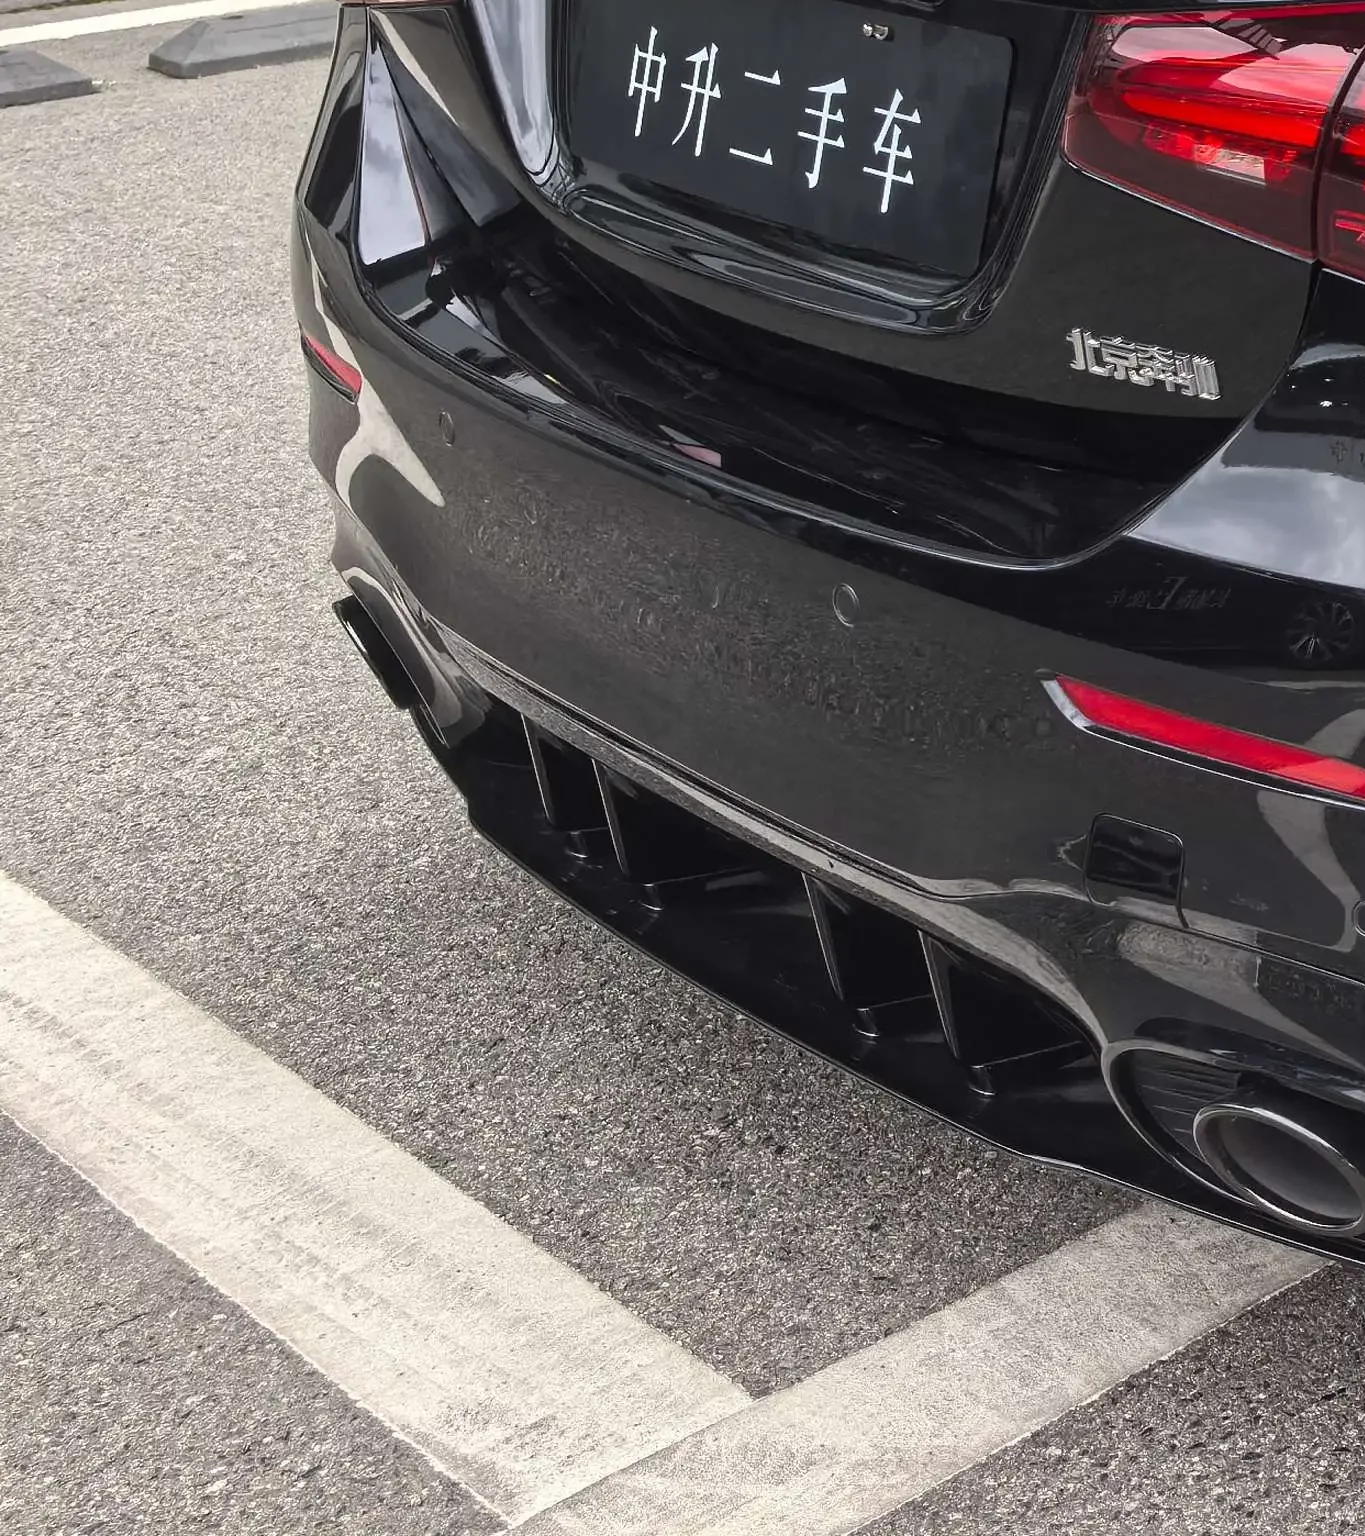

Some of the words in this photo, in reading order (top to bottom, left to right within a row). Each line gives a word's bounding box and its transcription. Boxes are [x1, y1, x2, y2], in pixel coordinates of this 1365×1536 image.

[628, 26, 922, 214] 中升二手车
